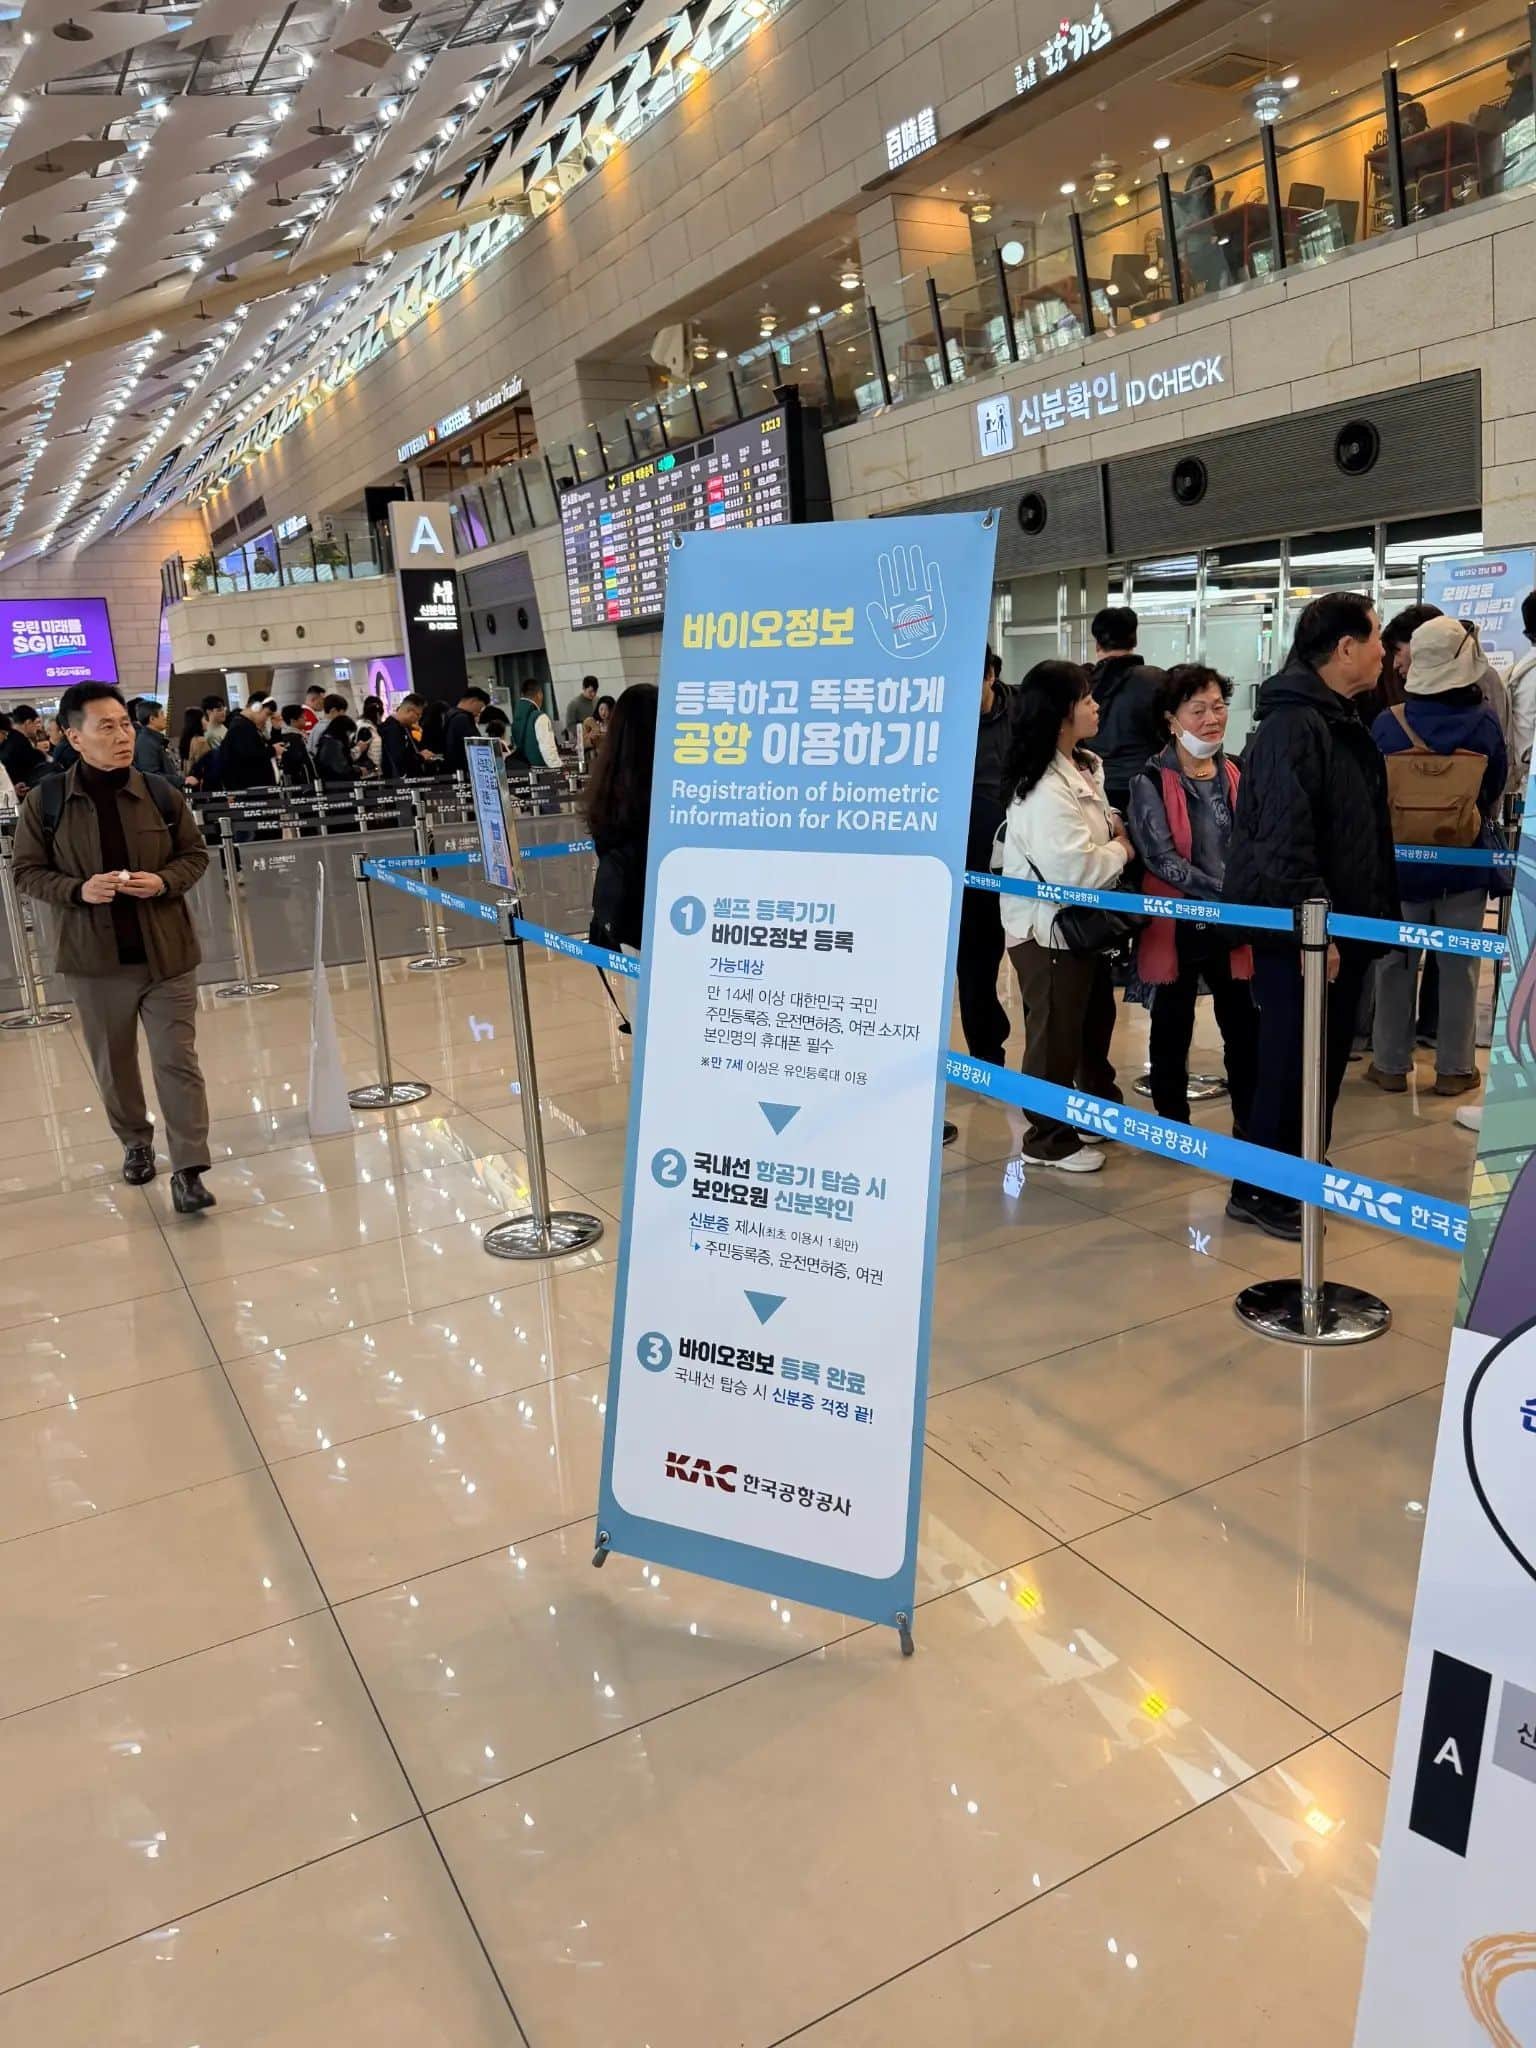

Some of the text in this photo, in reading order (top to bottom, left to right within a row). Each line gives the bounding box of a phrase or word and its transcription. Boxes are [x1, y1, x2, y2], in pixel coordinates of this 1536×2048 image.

[1017, 355, 1224, 436] 신분확인 ID CHECK
[397, 434, 429, 462] LOTTERIA
[410, 515, 445, 554] A
[12, 620, 40, 634] 우린
[682, 607, 855, 649] 바이오정보
[675, 676, 945, 715] 등록하고 똑똑하게
[673, 720, 940, 766] 공항 이용하기!
[671, 780, 941, 804] Registration of biometric
[669, 805, 939, 831] information for KOREAN
[1037, 884, 1062, 900] KAC
[1143, 897, 1221, 918] KAC 한국공항공사
[680, 902, 693, 930] 1
[713, 897, 836, 924] 셀프 등록기기
[711, 923, 854, 953] 바이오정보 등록
[1399, 925, 1505, 954] KAC 한국공항공
[709, 957, 765, 976] 가능대상
[707, 985, 878, 1015] 만 14세 이상 대한민국 국민
[705, 1006, 921, 1041] 주민등록증, 운전면허증, 여권 소지자
[703, 1027, 835, 1055] 본인명의 휴대폰 필수
[726, 1057, 743, 1072] 7세
[845, 1070, 868, 1086] 이용
[1066, 1095, 1209, 1159] KAC 한국공항공사
[661, 1154, 679, 1181] 2
[693, 1151, 887, 1200] 국내선 항공기 탑승 시
[691, 1178, 854, 1222] 보안요원 신분확인
[1322, 1173, 1403, 1225] KAC
[689, 1212, 730, 1233] 신분증
[790, 1231, 823, 1248] 이용시
[828, 1236, 859, 1254] 1회만)
[704, 1239, 884, 1286] 주민등록증, 운전면허증, 여권
[647, 1337, 664, 1364] 3
[678, 1336, 867, 1395] 바이오정보 등록 완료
[674, 1366, 874, 1425] 국내선 탑승 시 신분증 걱정 끝!
[664, 1451, 853, 1517] KAC 한국공항공사
[1433, 1737, 1463, 1776] A
